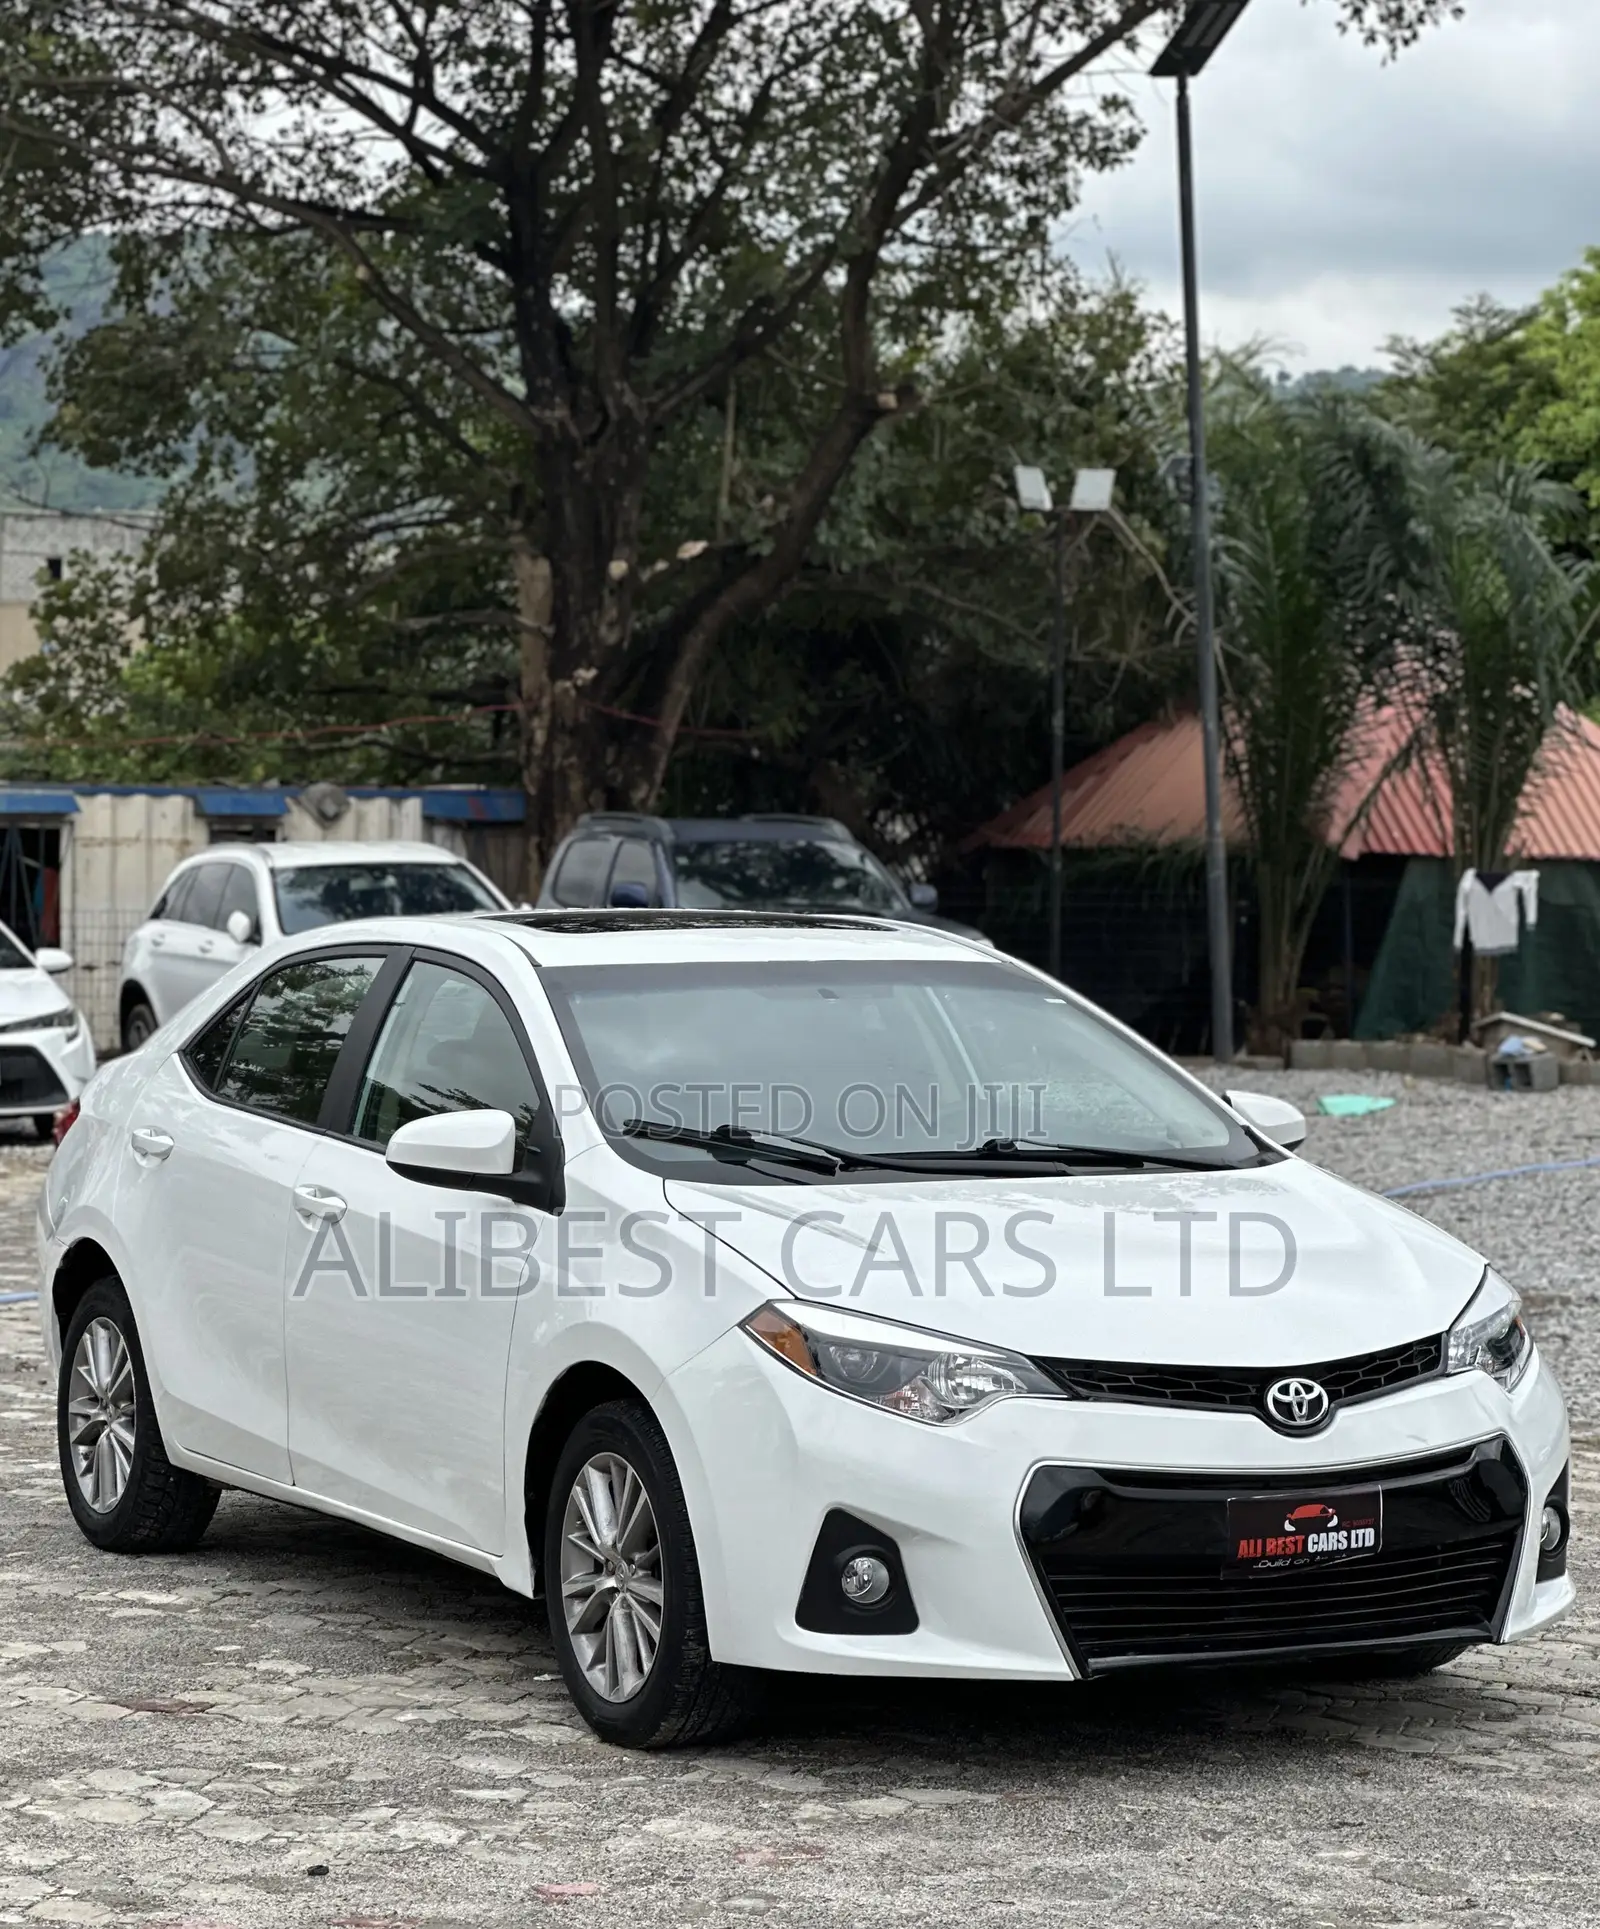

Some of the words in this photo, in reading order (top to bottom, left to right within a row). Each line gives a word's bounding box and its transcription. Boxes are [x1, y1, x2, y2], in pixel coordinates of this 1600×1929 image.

[1237, 1538, 1262, 1560] ALI
[1264, 1535, 1305, 1557] BEST
[1307, 1532, 1348, 1553] CARS
[1350, 1527, 1375, 1549] LTD
